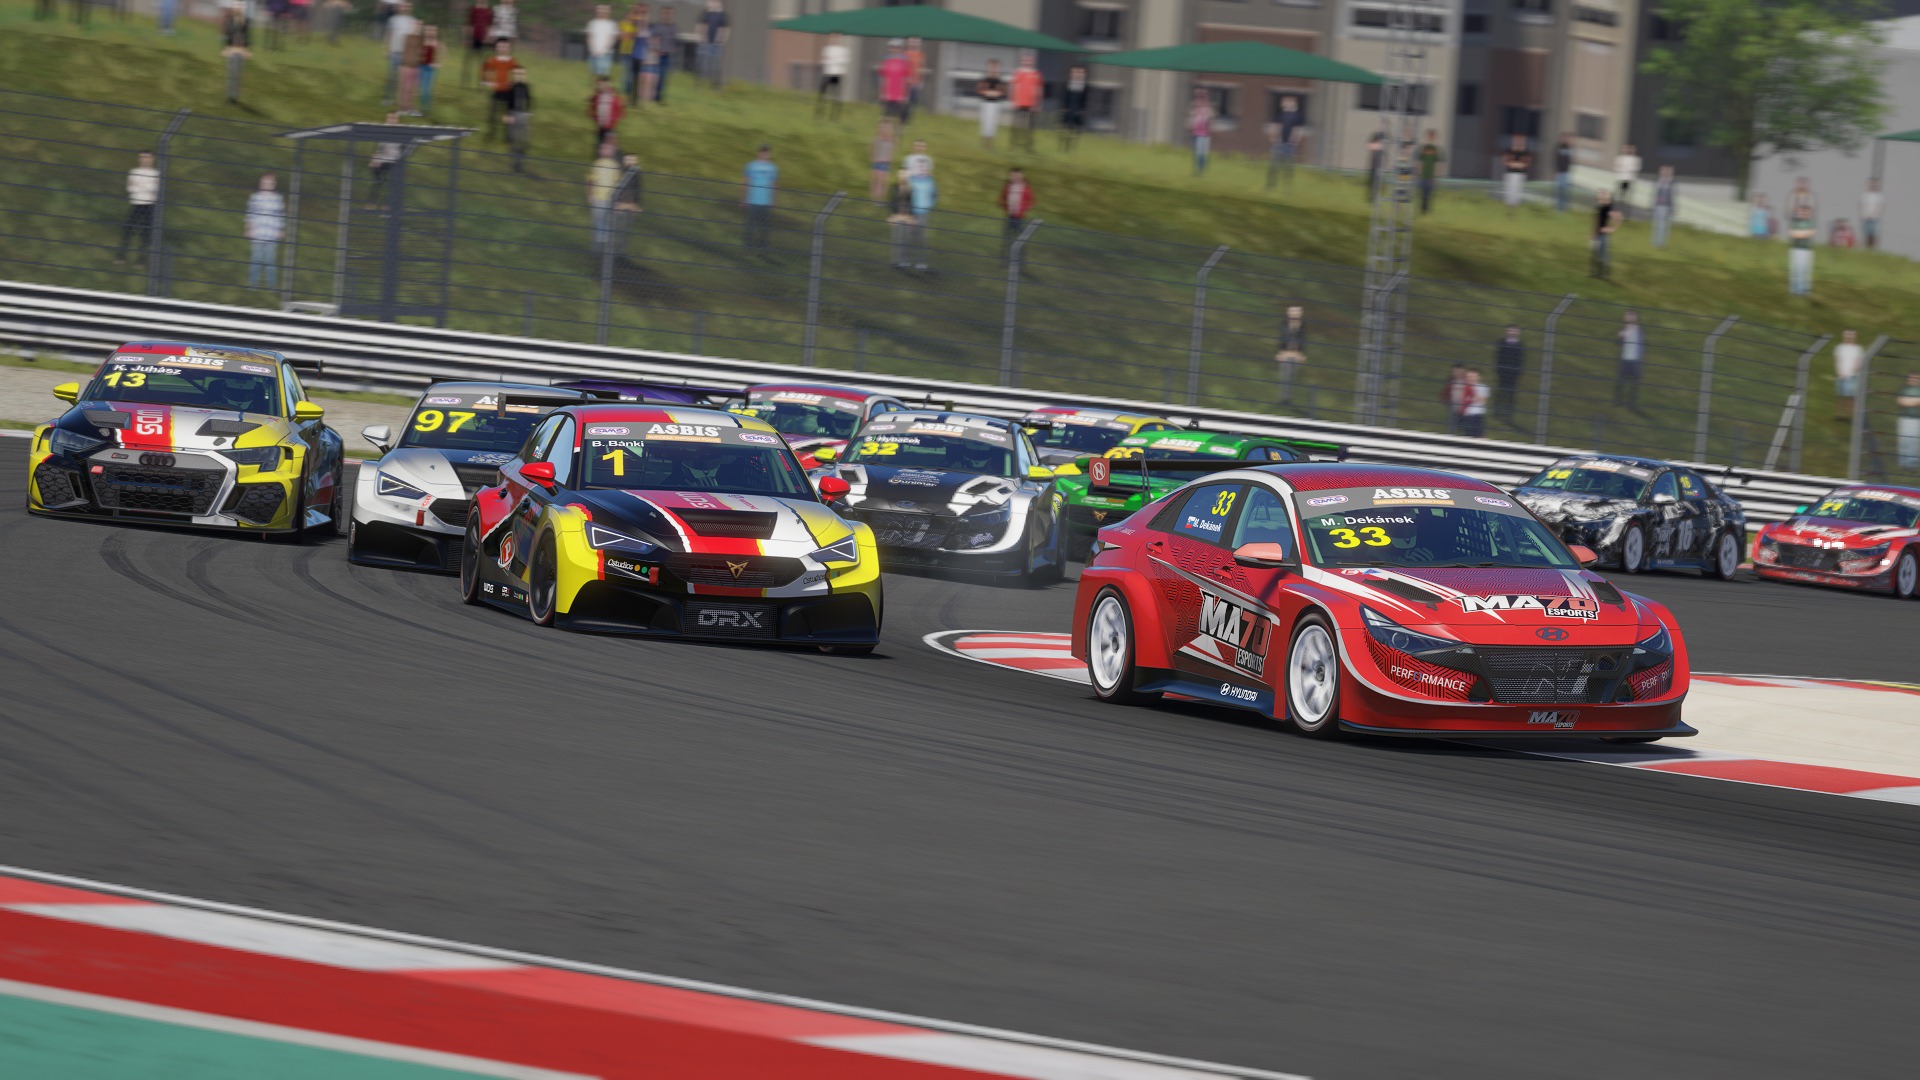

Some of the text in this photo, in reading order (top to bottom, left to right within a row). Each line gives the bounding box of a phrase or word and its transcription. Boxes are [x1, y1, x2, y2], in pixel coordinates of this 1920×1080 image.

[162, 355, 224, 366] ASBIS
[103, 371, 147, 388] 13
[414, 410, 476, 433] 97
[647, 423, 720, 437] ASBIS
[911, 422, 965, 433] ASBIS
[860, 442, 899, 455] 32
[602, 449, 624, 476] 1
[1373, 488, 1451, 499] ASBIS
[1211, 490, 1236, 516] 33
[1321, 514, 1415, 527] M. Dekánek
[1328, 526, 1392, 549] 33
[1463, 595, 1597, 612] MA70
[1547, 608, 1595, 618] ESPORTS
[1200, 594, 1271, 656] MA70
[1237, 648, 1263, 673] ESPORTS
[1390, 665, 1466, 692] PERFORMANCE
[1230, 686, 1258, 702] HYUNDAI
